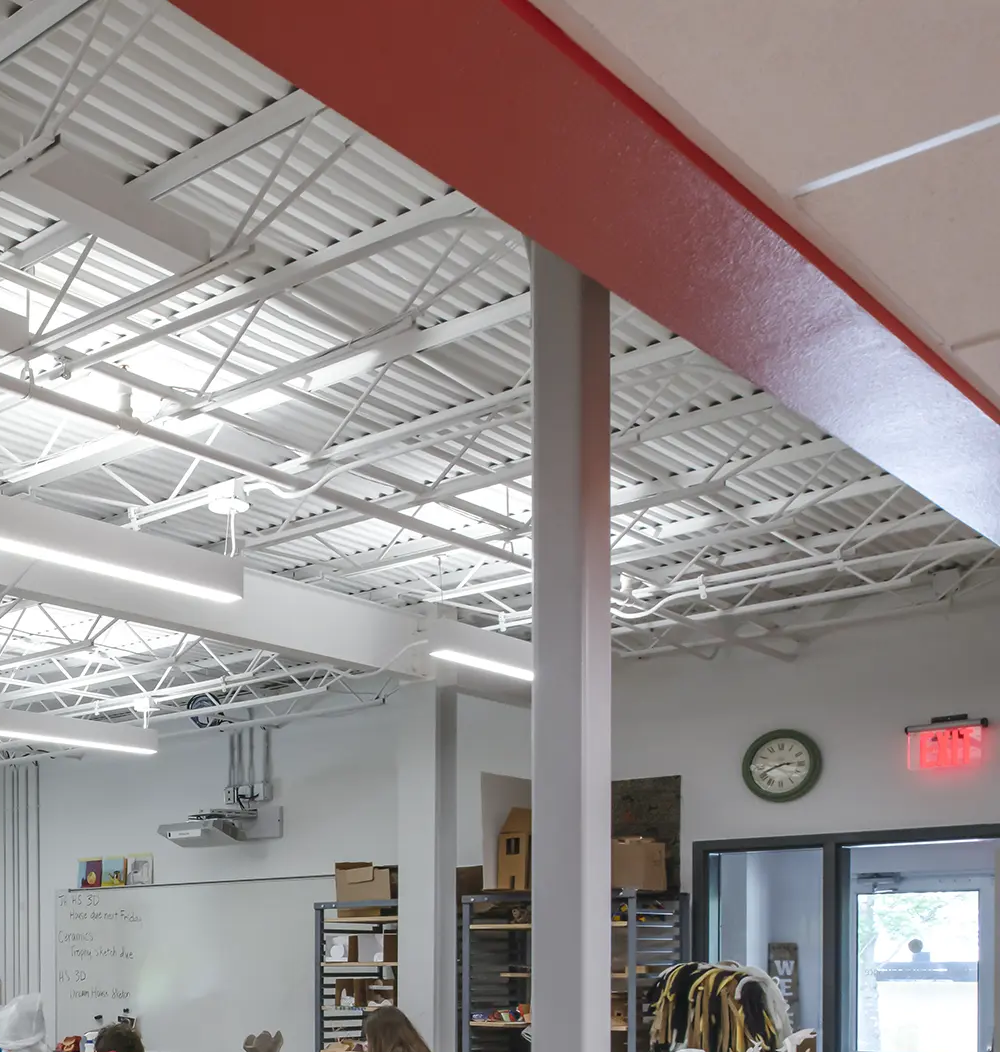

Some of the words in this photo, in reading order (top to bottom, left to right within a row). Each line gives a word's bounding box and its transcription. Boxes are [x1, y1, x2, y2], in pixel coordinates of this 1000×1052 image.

[920, 727, 973, 768] EXIT
[87, 894, 100, 907] 3D
[75, 969, 87, 982] 3D
